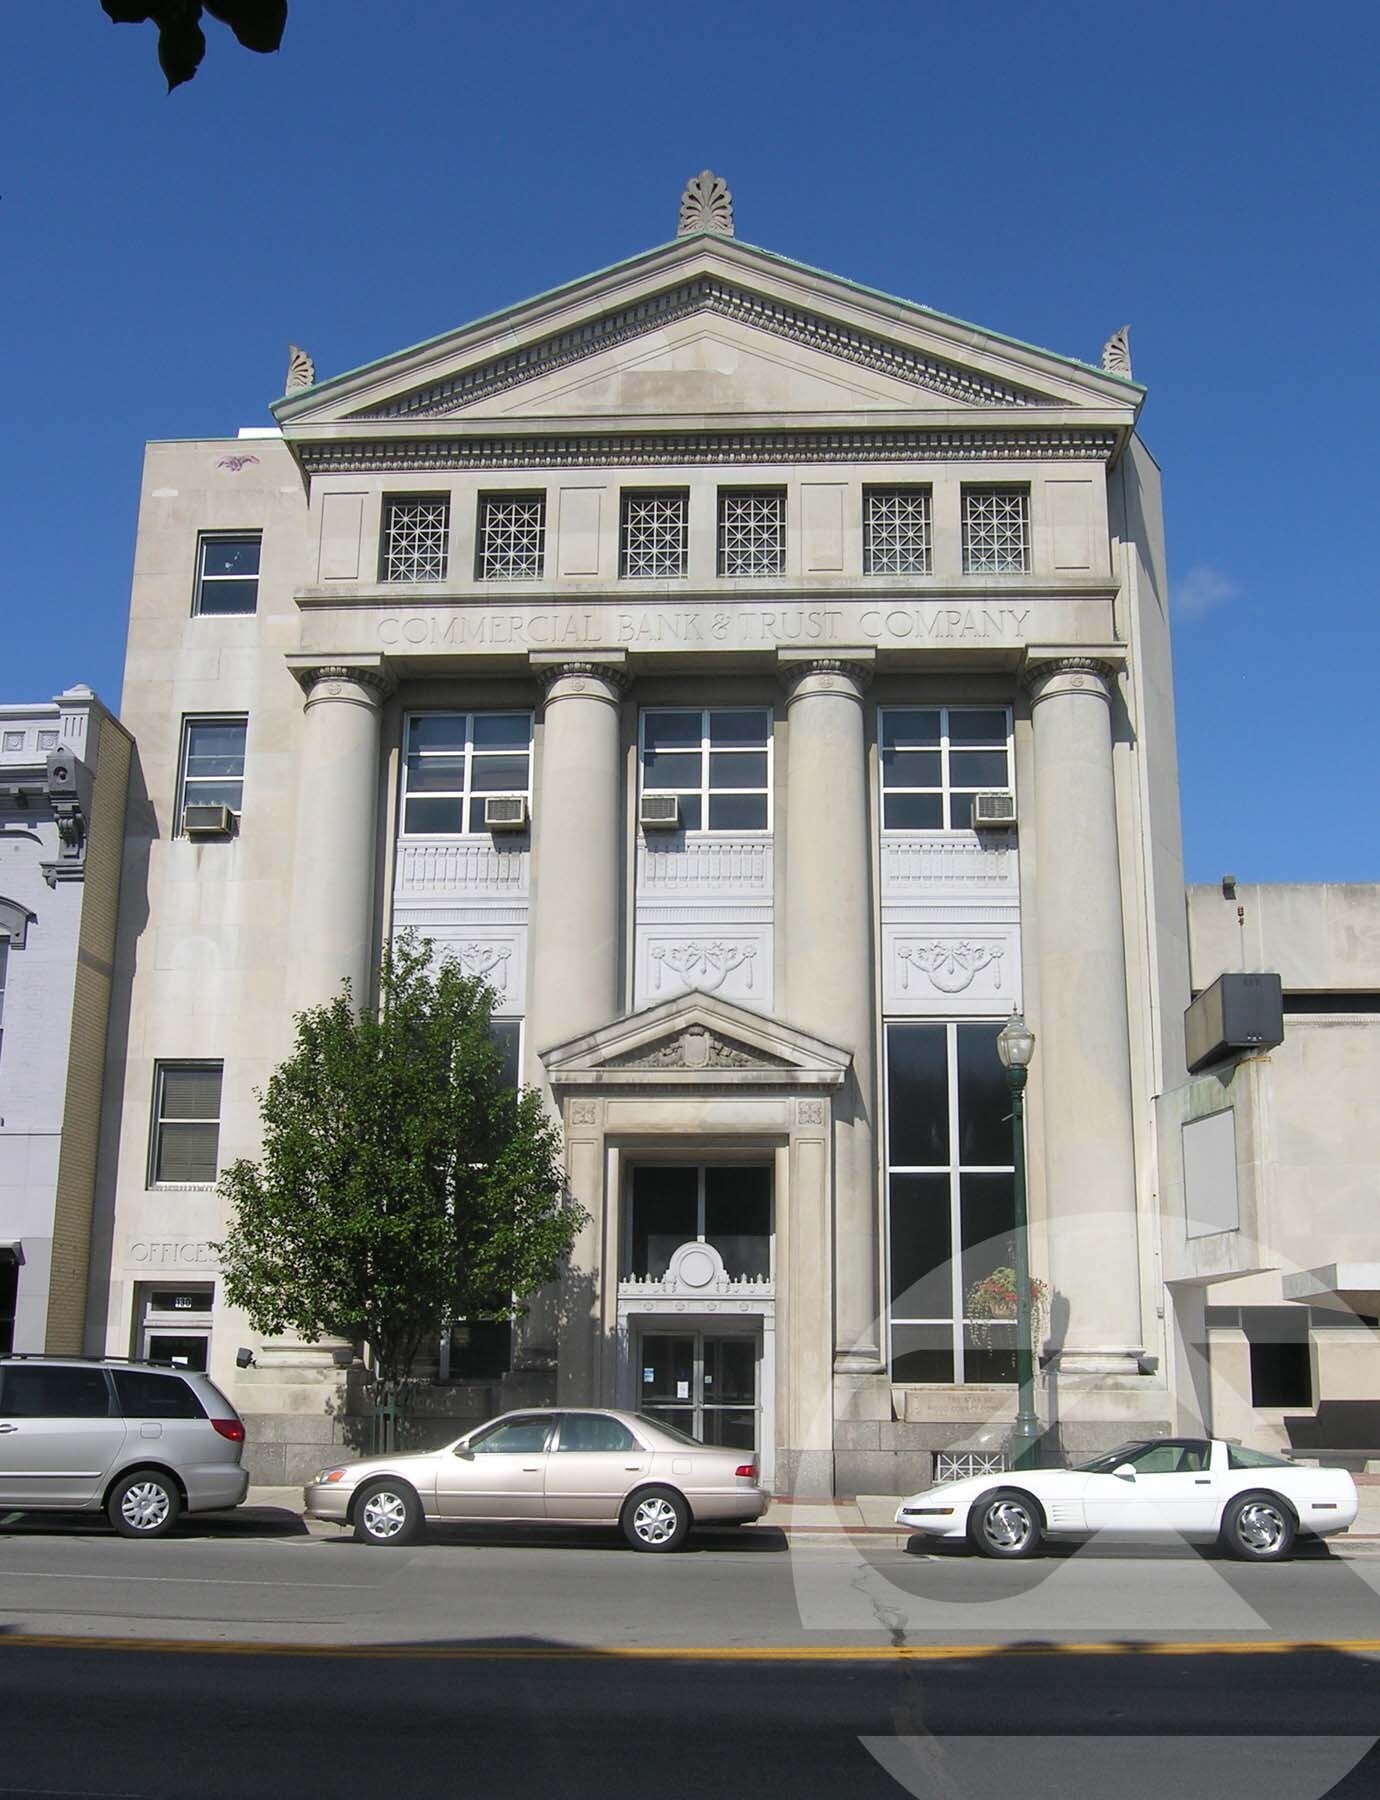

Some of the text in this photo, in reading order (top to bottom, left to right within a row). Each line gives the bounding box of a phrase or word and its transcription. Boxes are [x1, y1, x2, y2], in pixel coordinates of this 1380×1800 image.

[378, 610, 1031, 644] COMMERCIAL BANK & TRUST COMPANY
